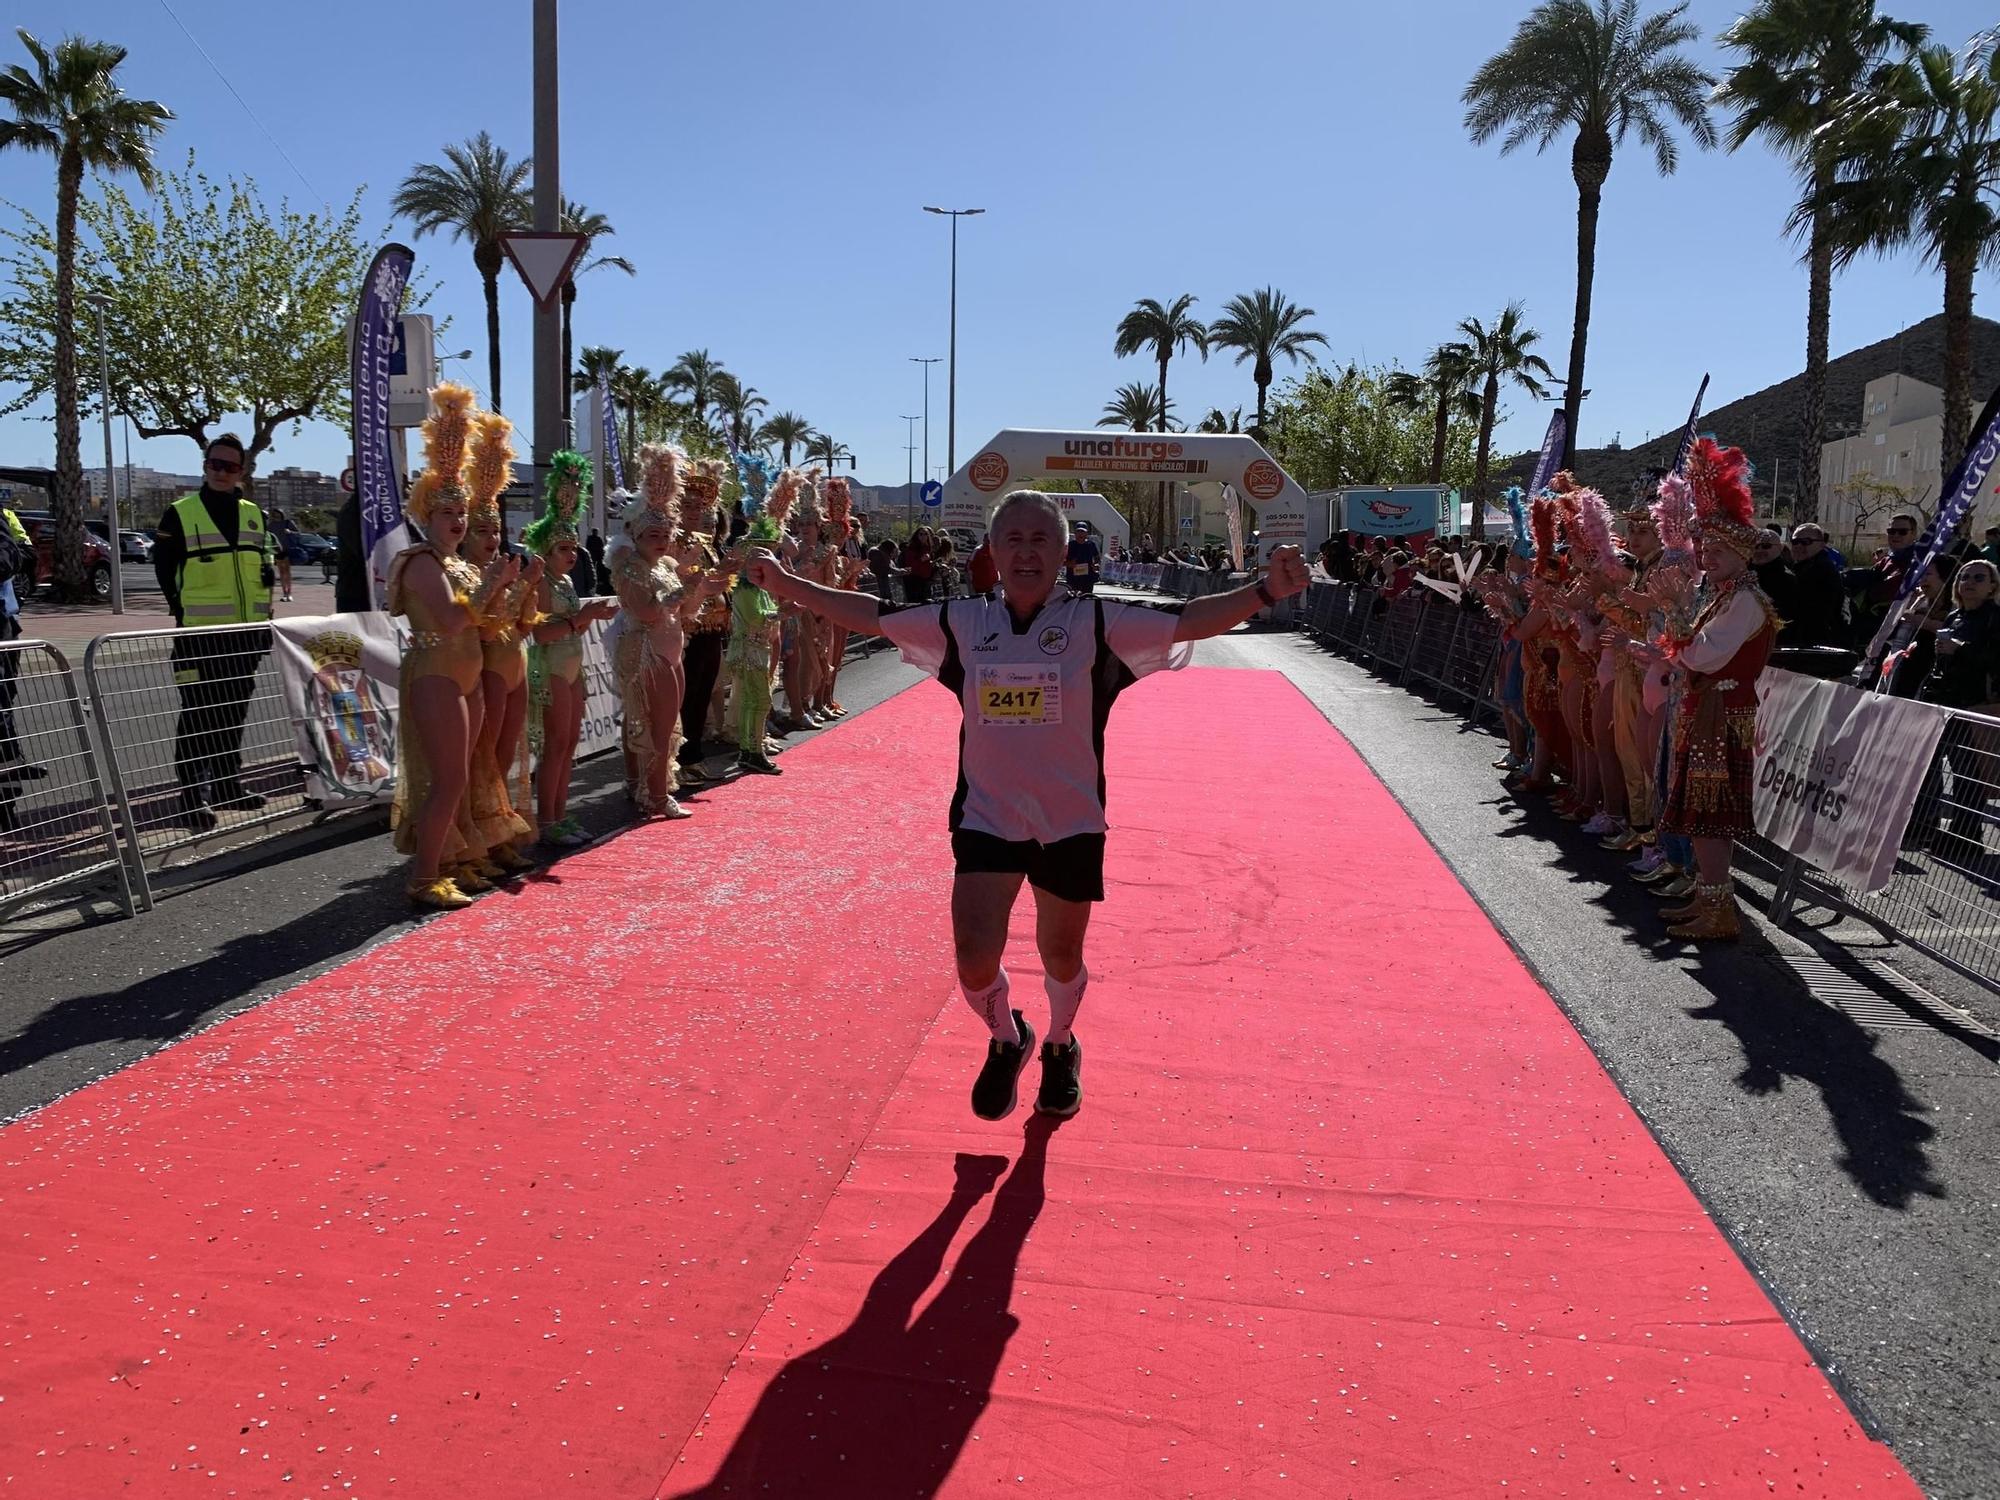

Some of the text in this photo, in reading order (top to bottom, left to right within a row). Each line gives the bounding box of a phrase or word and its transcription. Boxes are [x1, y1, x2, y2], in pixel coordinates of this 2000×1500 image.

[359, 321, 374, 523] Ayuntamiento
[1074, 459, 1104, 469] ALQUILER
[1105, 460, 1111, 470] Y
[1111, 460, 1138, 470] RENTING
[1140, 460, 1150, 470] DE
[988, 691, 1041, 707] 2417
[1759, 755, 1848, 822] Deportes
